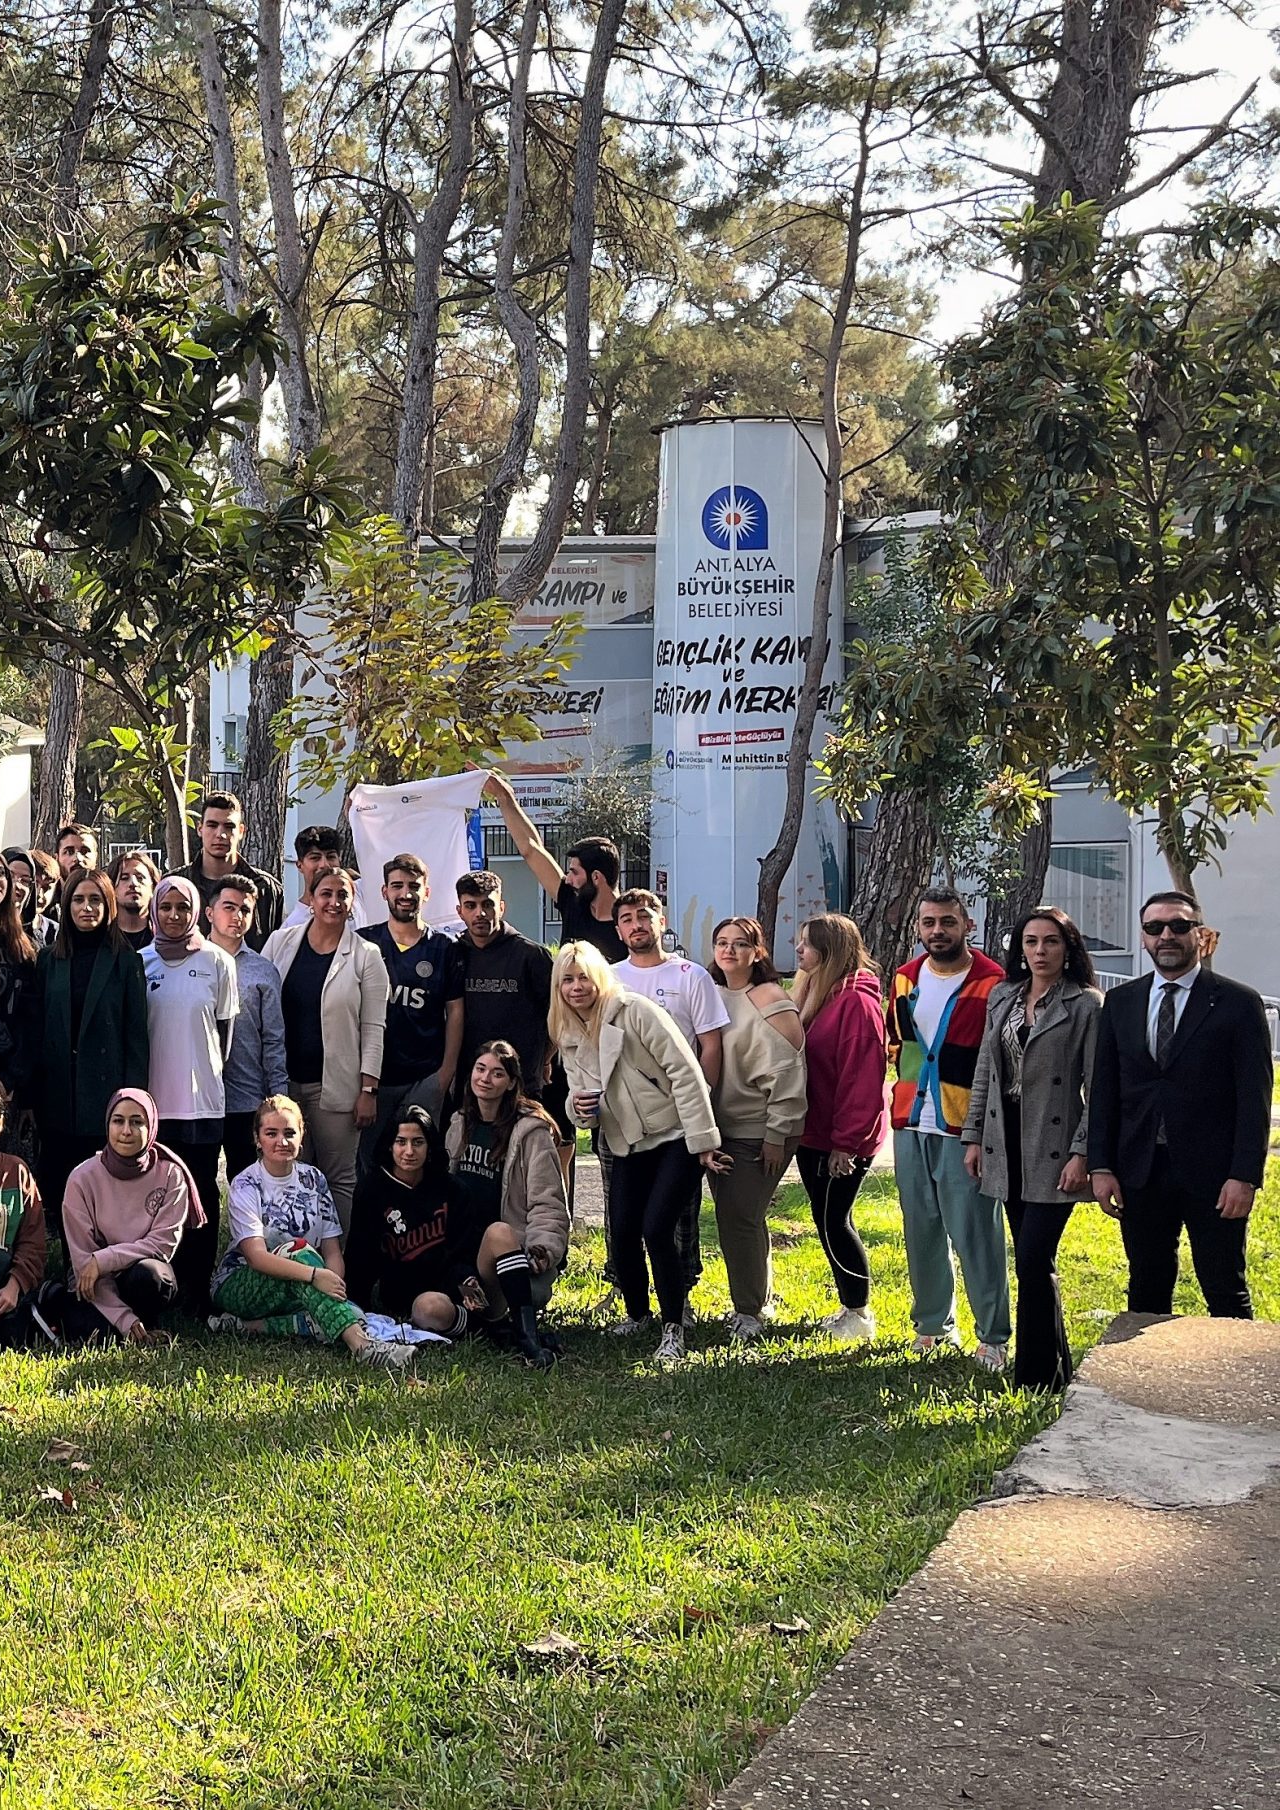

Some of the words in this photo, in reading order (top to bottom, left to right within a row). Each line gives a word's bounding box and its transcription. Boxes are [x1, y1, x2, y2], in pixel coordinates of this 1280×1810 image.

[694, 557, 776, 573] ANTALYA
[677, 575, 795, 598] BÜYÜKŞEHİR
[611, 590, 628, 604] ve
[688, 598, 783, 618] BELEDİYESİ
[656, 634, 746, 672] GENÇLİK
[750, 635, 832, 666] KAMI
[723, 667, 745, 682] ve
[654, 682, 712, 717] EĞİTİM
[718, 681, 837, 714] MERKZİ
[722, 753, 774, 763] Muhittin
[388, 984, 426, 1009] VIS
